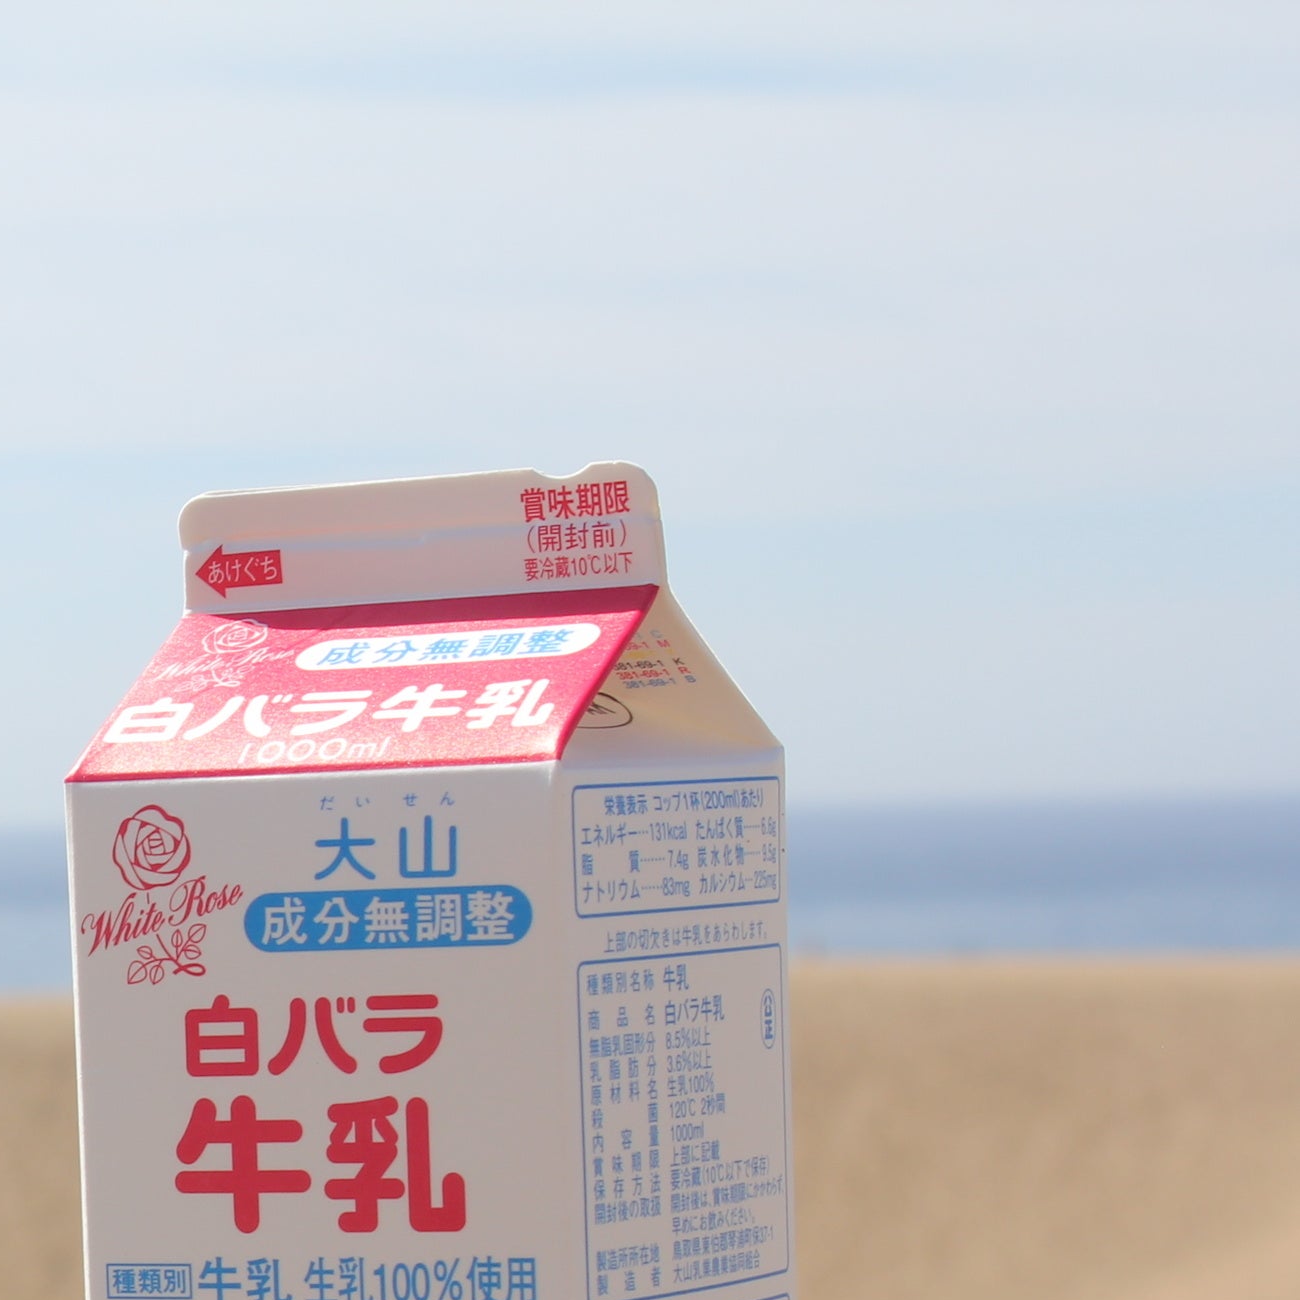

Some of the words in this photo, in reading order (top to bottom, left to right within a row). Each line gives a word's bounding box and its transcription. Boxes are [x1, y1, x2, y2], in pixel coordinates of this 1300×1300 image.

[520, 481, 630, 523] 賞味期限
[208, 556, 278, 584] あけぐち
[524, 552, 633, 581] 要冷蔵10℃以下
[320, 626, 575, 667] 成分無調整
[103, 678, 553, 743] 白バラ牛乳
[238, 736, 392, 765] 1000ml
[320, 791, 456, 810] だいせん
[314, 815, 457, 880] 大山
[81, 892, 165, 957] White
[168, 875, 243, 927] Rose
[262, 891, 515, 946] 成分無調整
[663, 963, 689, 992] 牛乳
[664, 994, 725, 1026] 白バラ牛乳
[185, 994, 443, 1077] 白バラ
[175, 1095, 466, 1234] 牛乳
[113, 1267, 186, 1295] 種類別
